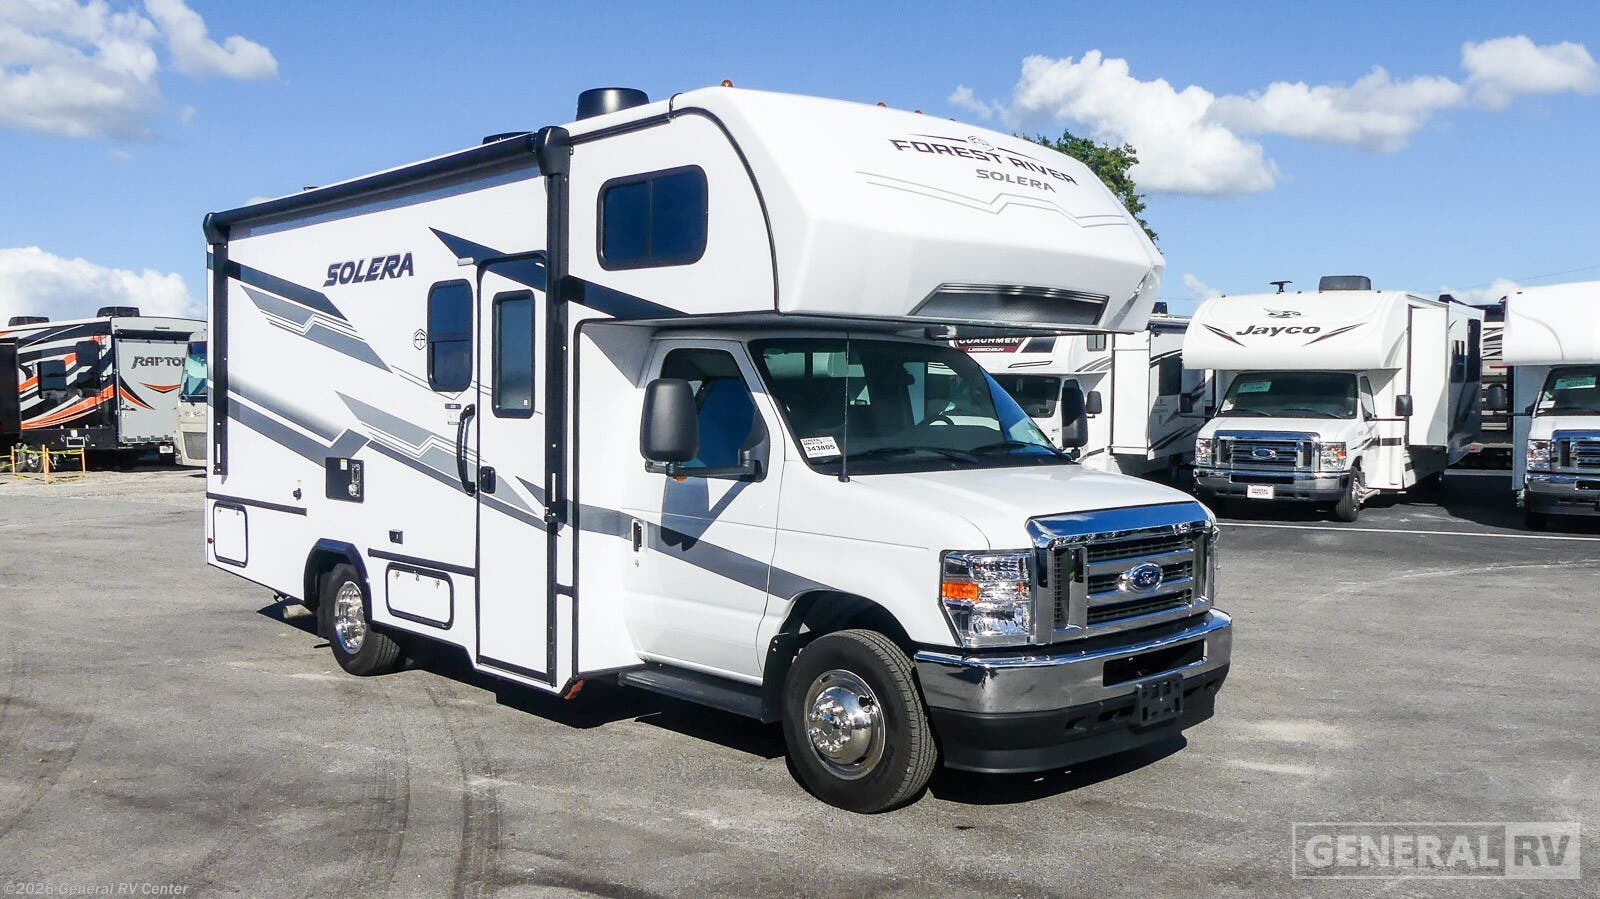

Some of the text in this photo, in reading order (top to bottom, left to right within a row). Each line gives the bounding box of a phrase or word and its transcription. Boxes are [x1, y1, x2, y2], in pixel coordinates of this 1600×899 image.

[888, 139, 1079, 186] FOREST RIVER
[975, 168, 1057, 193] SOLERA
[324, 252, 414, 287] SOLERA
[1235, 325, 1321, 337] Jayco
[806, 444, 836, 452] 343805
